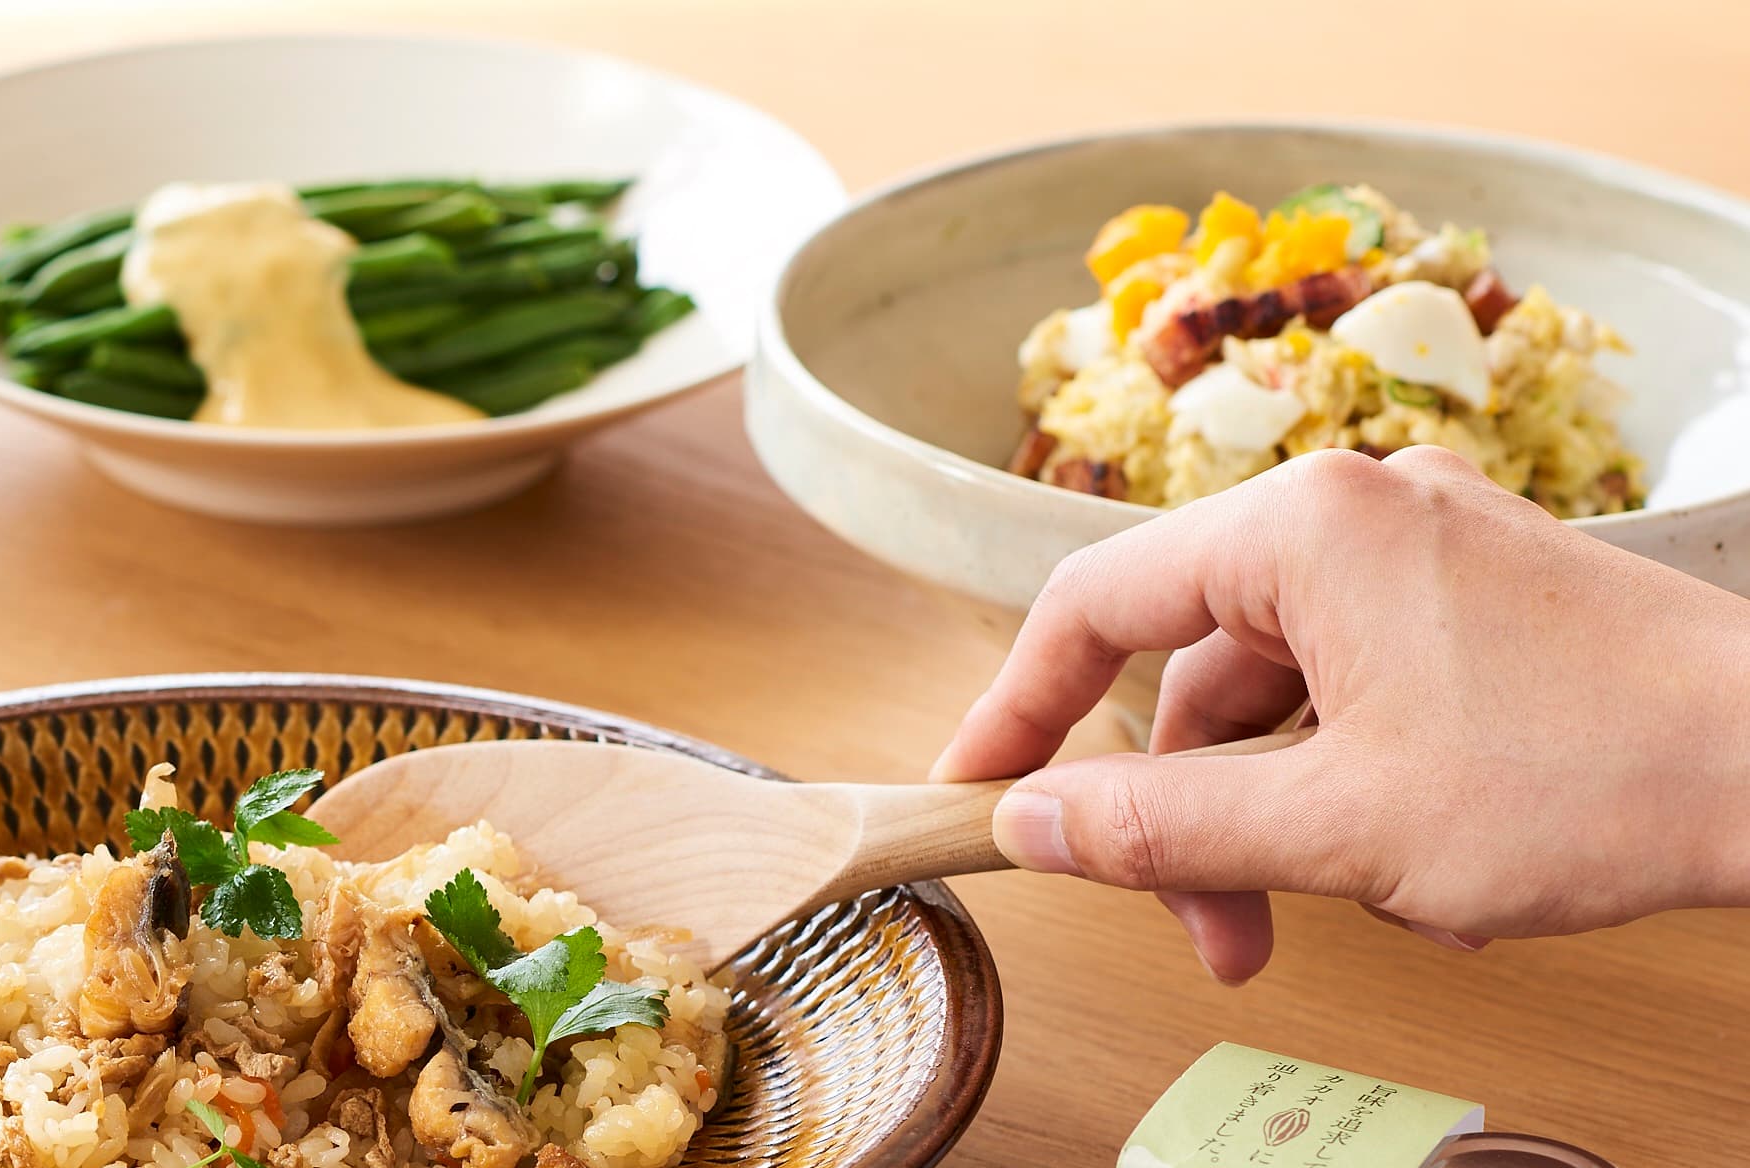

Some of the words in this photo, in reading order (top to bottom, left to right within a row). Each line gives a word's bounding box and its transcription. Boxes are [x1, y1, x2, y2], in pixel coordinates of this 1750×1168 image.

[1198, 1061, 1299, 1163] 辿り着きました。
